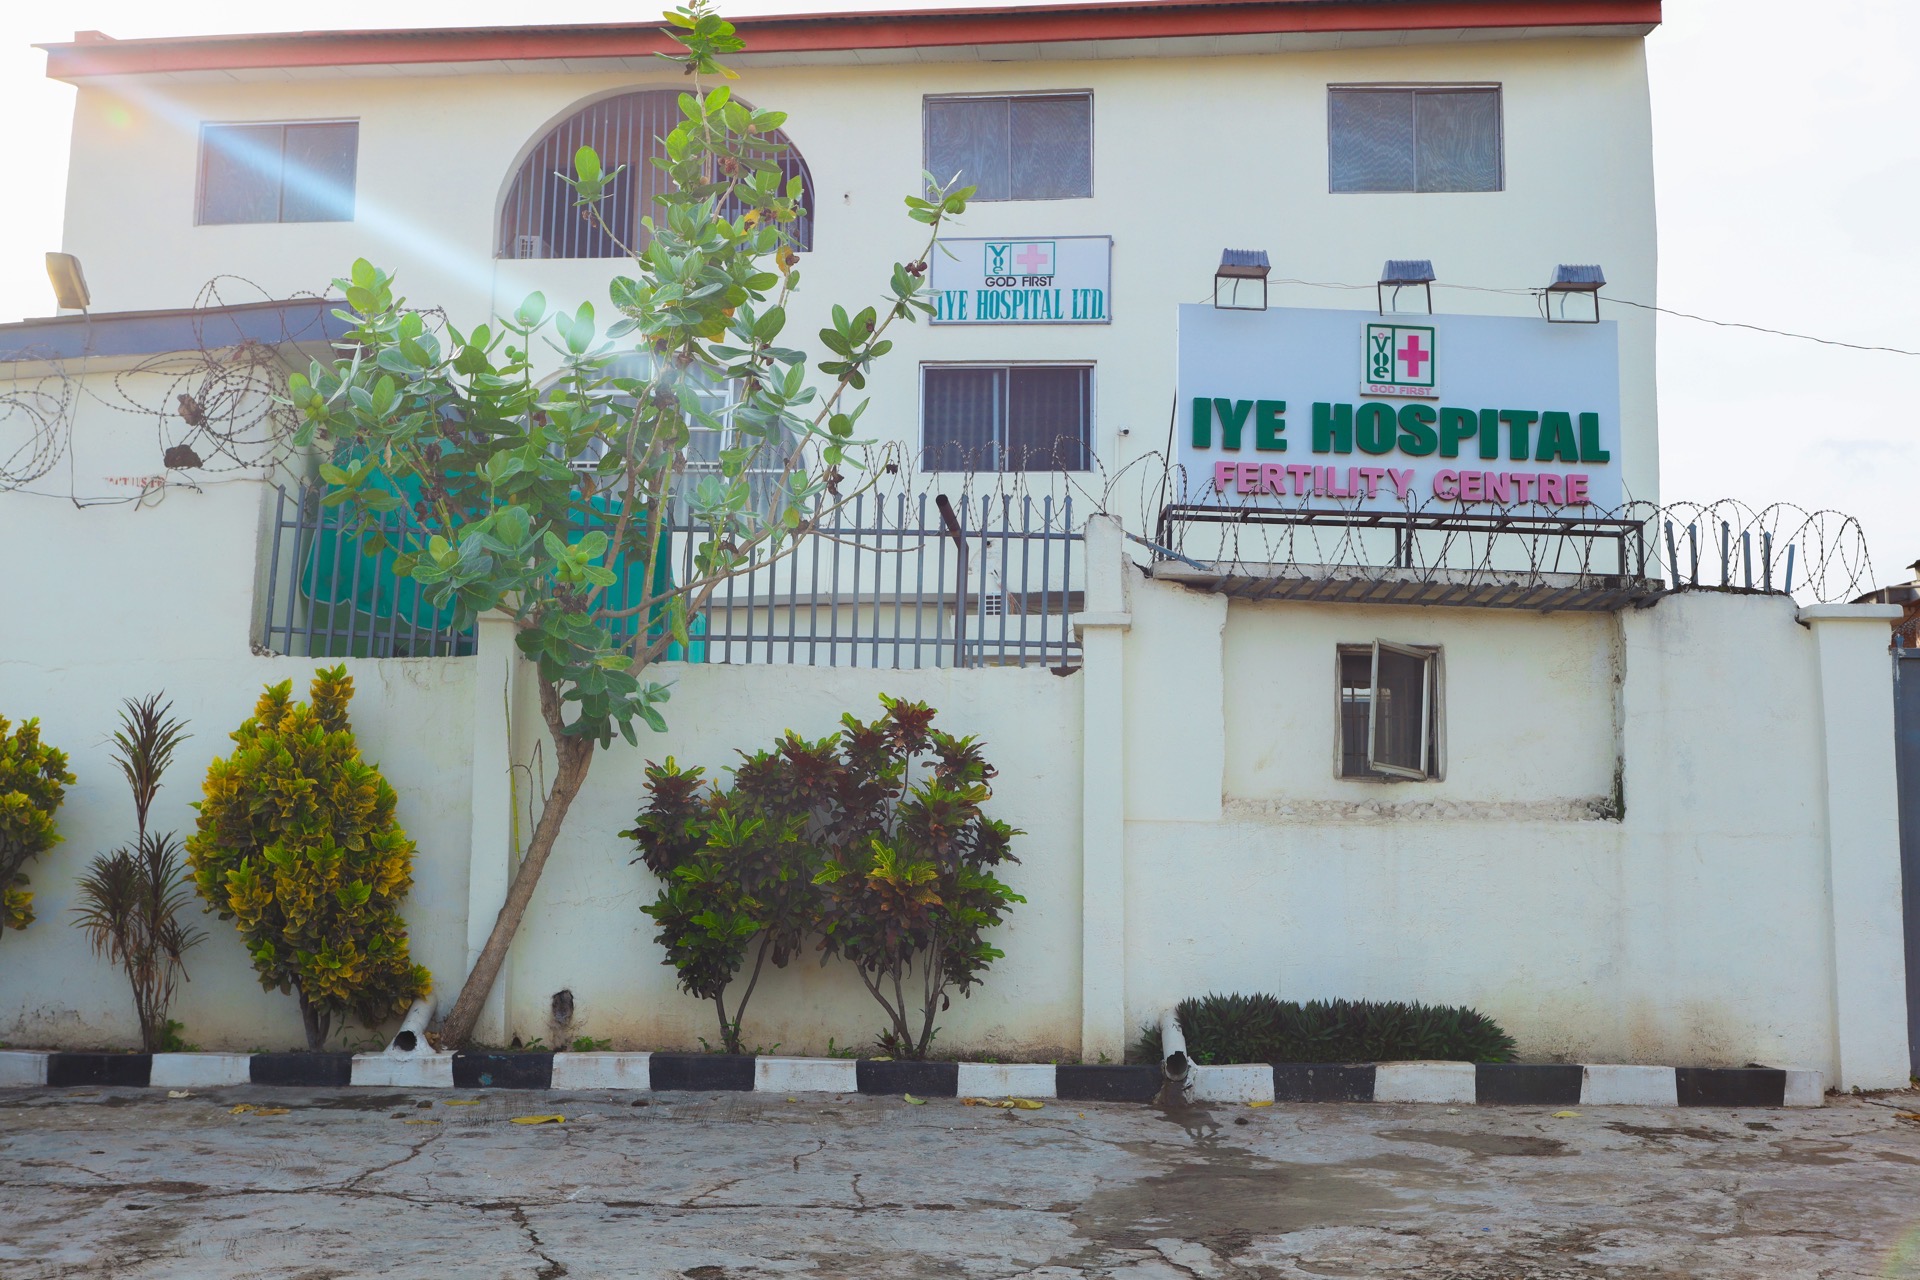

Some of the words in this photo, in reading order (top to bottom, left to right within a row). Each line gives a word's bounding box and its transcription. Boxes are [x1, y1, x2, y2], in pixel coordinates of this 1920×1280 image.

[985, 276, 1017, 287] GOD
[1022, 276, 1054, 287] FIRST
[936, 290, 968, 320] IYE
[975, 288, 1065, 320] HOSPITAL
[1071, 288, 1106, 320] LTD.
[1370, 384, 1396, 394] GOD
[1399, 386, 1432, 396] FIRST
[1191, 396, 1288, 452] IYE
[1311, 401, 1611, 463] HOSPITAL
[1214, 461, 1416, 500] FERTILITY
[1432, 468, 1590, 506] CENTRE
